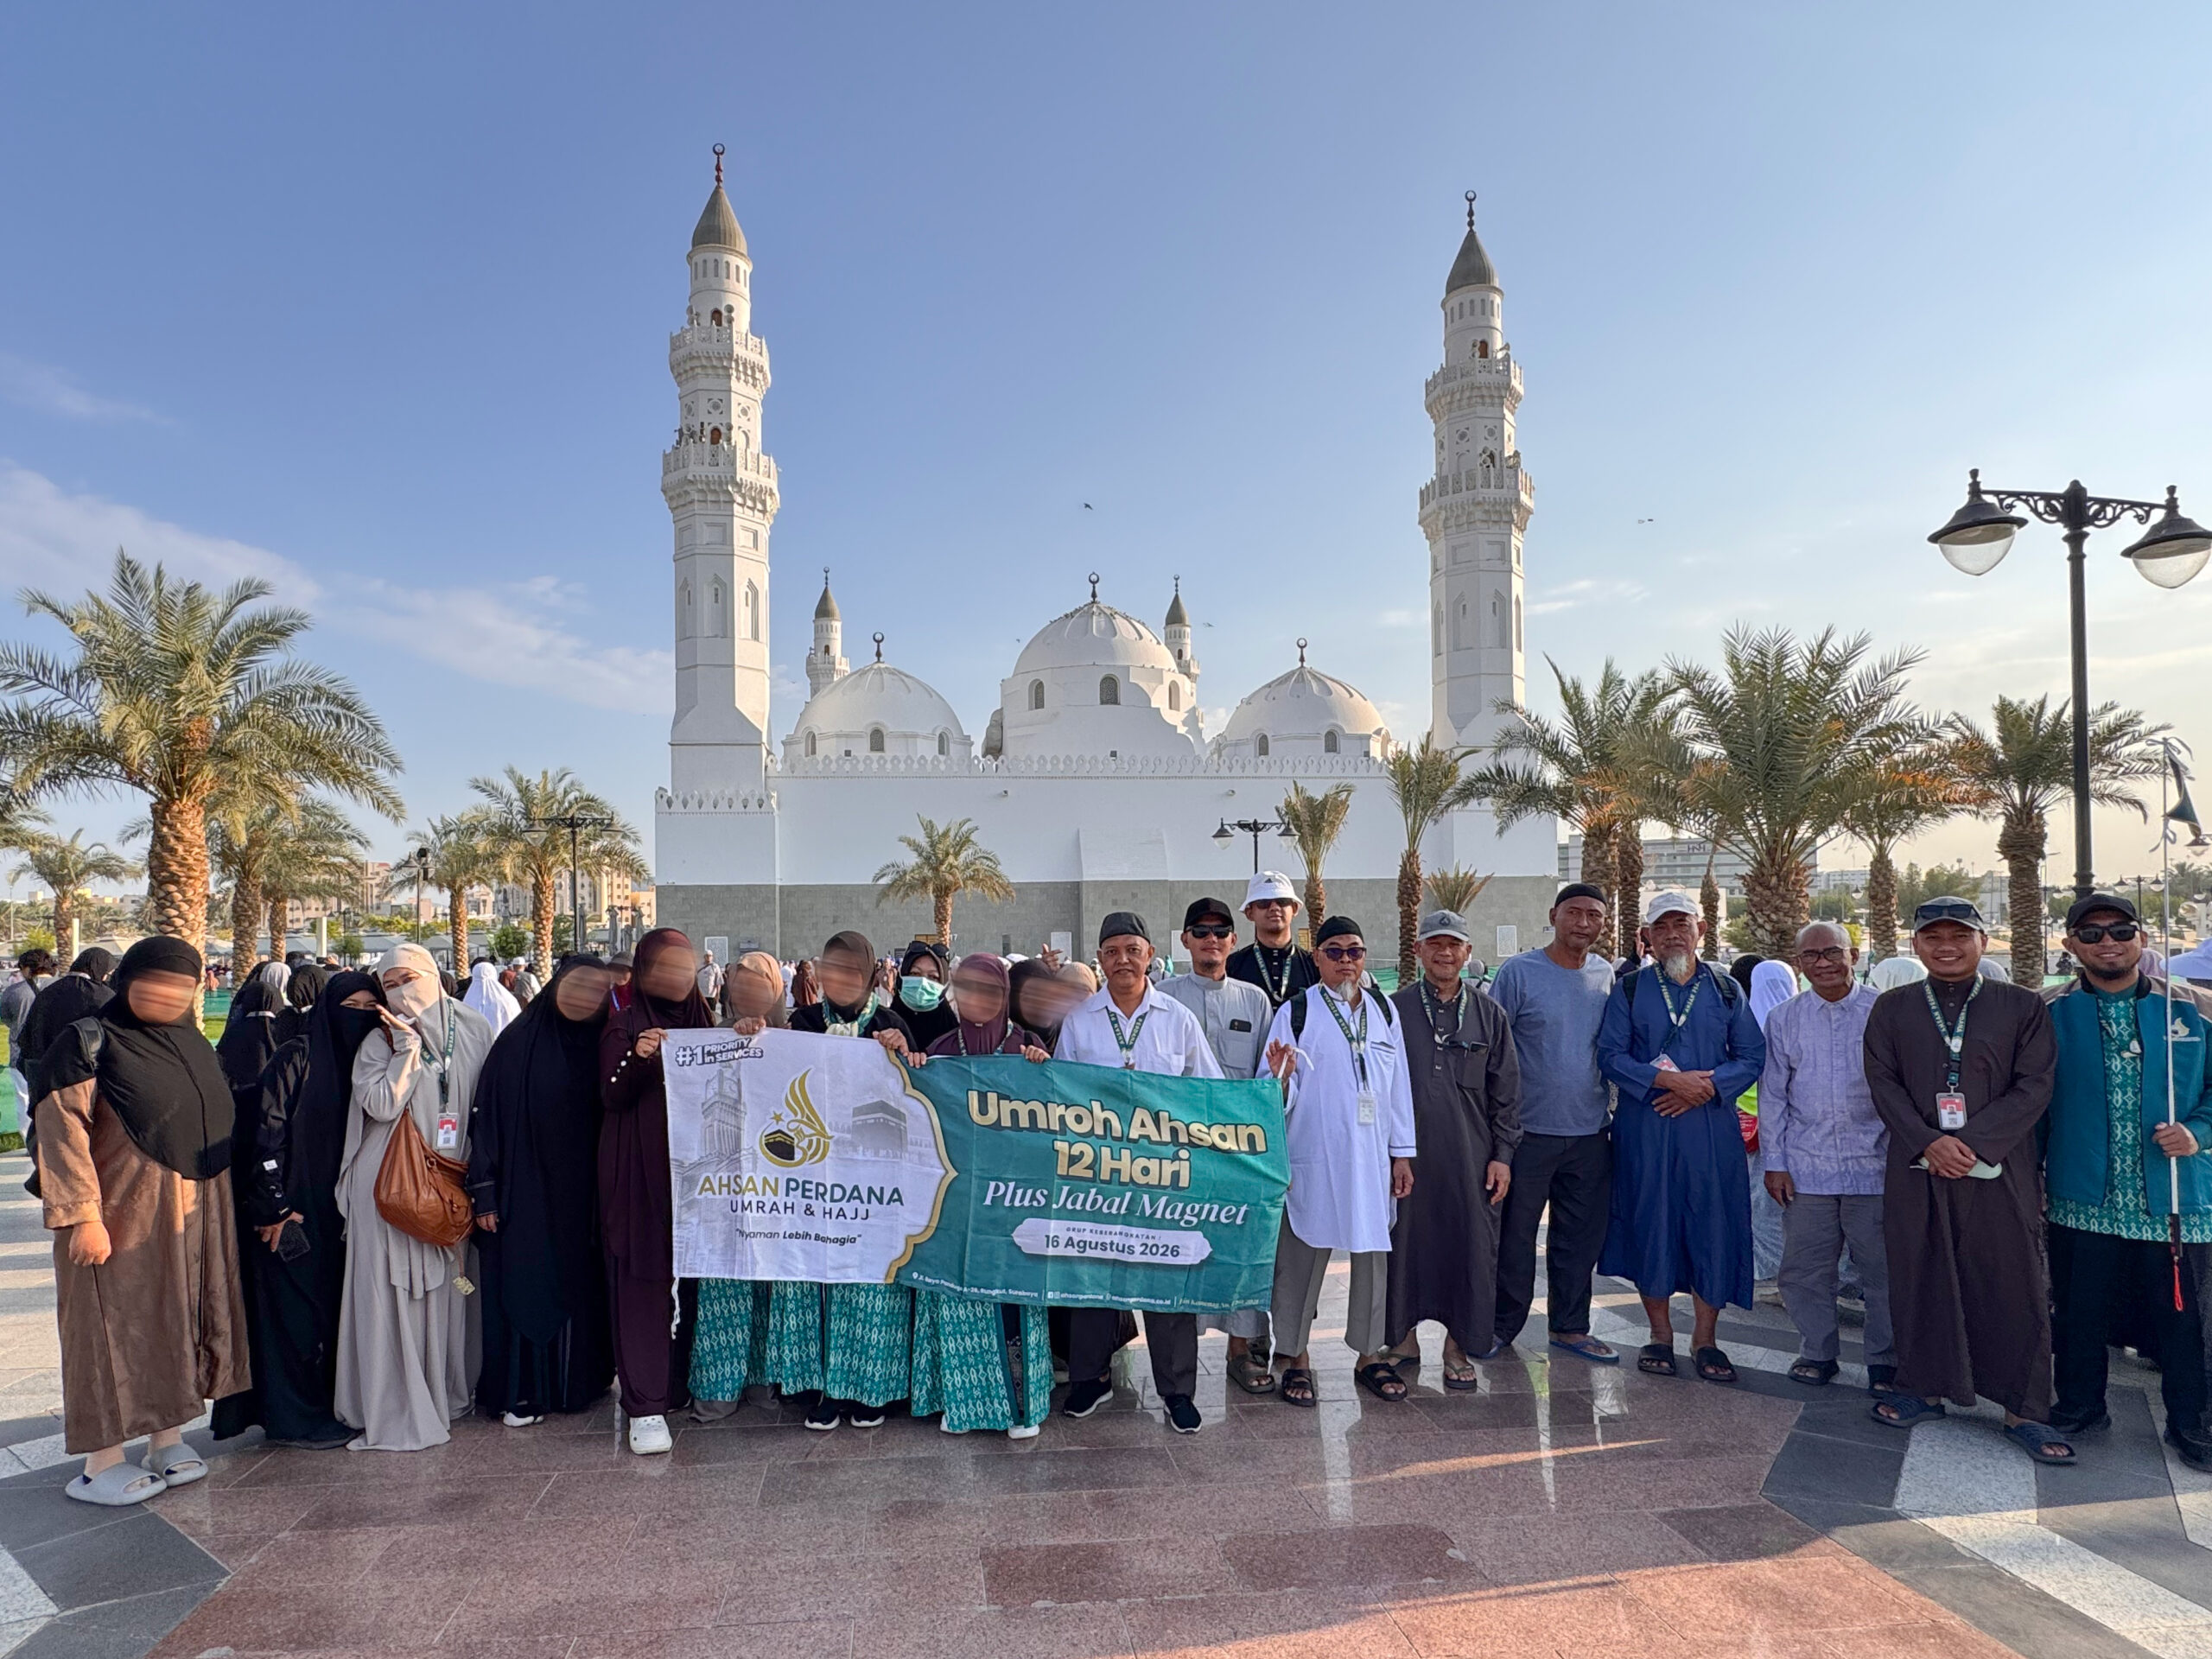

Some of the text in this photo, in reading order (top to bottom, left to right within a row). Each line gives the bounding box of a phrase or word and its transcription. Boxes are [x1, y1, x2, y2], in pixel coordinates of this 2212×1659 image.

[676, 1038, 751, 1066] #1 PRIORITY
[715, 1048, 763, 1062] SERVICES
[968, 1090, 1267, 1154] Umroh Ahsan
[1052, 1140, 1192, 1189] 12 Hari
[697, 1175, 905, 1207] AHSAN PERDANA
[983, 1180, 1249, 1228] Plus Jabal Magnet
[730, 1199, 870, 1221] UMRAH & HAJJ
[783, 1230, 812, 1241] Lebih
[1044, 1235, 1180, 1257] 16 Agustus 2026
